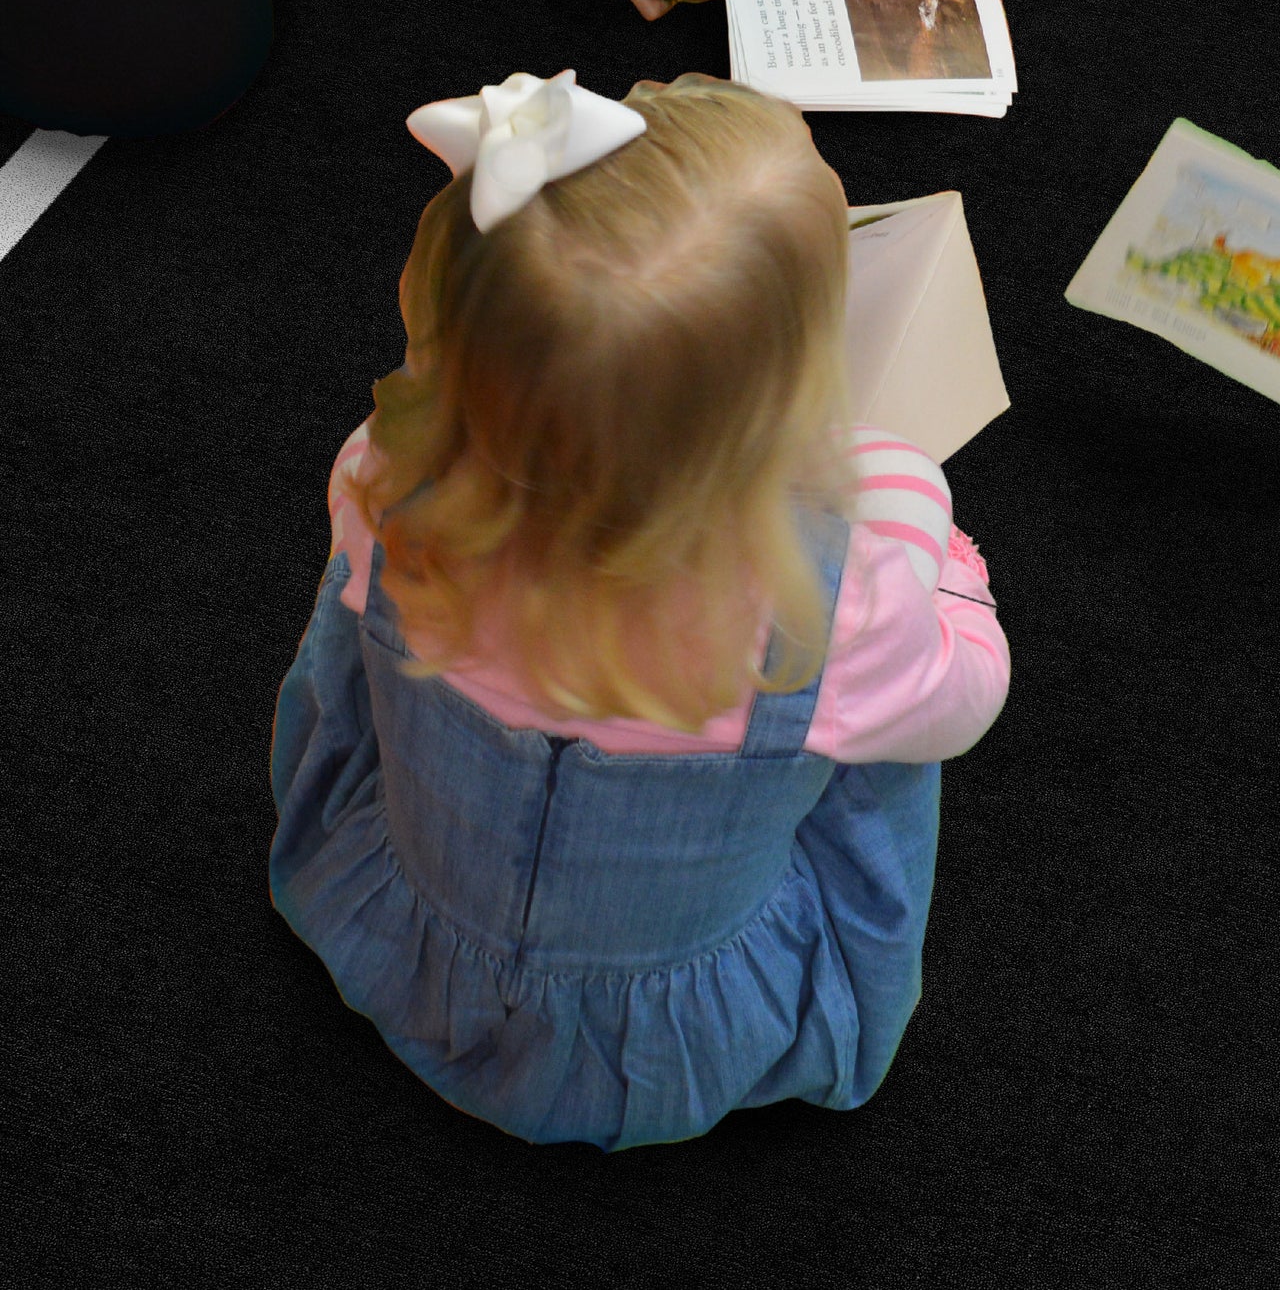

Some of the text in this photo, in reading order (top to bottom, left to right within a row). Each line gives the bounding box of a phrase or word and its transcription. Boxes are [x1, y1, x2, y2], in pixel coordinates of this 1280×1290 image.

[808, 2, 817, 14] for
[823, 0, 835, 16] and
[760, 10, 768, 24] can
[777, 10, 786, 30] long
[813, 18, 823, 40] hour
[764, 30, 773, 47] they
[796, 24, 811, 66] breathing
[829, 20, 845, 66] crocodiles
[782, 42, 793, 66] water
[818, 43, 826, 53] an
[768, 52, 777, 68] But
